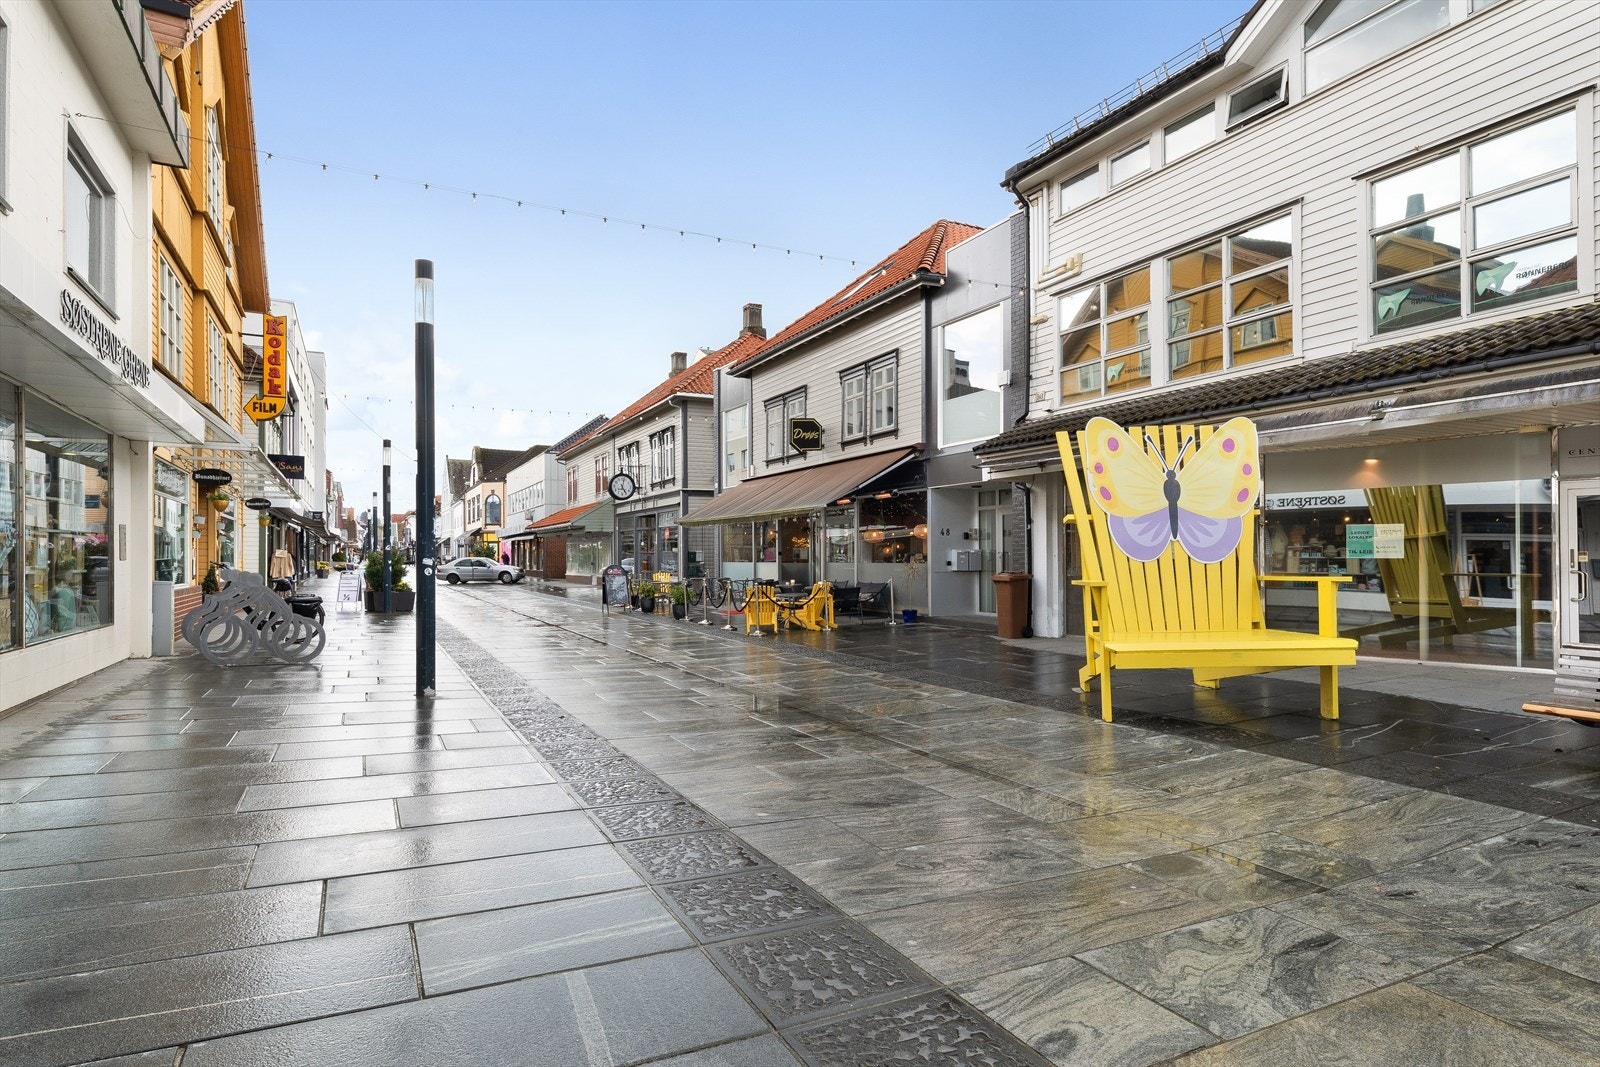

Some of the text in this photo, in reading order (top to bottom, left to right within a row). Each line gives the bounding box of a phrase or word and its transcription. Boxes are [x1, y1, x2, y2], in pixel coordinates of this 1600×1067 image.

[60, 288, 150, 389] SØSTRENE GRENE
[266, 318, 284, 395] Kodak
[253, 402, 277, 413] FILM
[1569, 447, 1600, 456] CEN
[940, 528, 950, 536] 48
